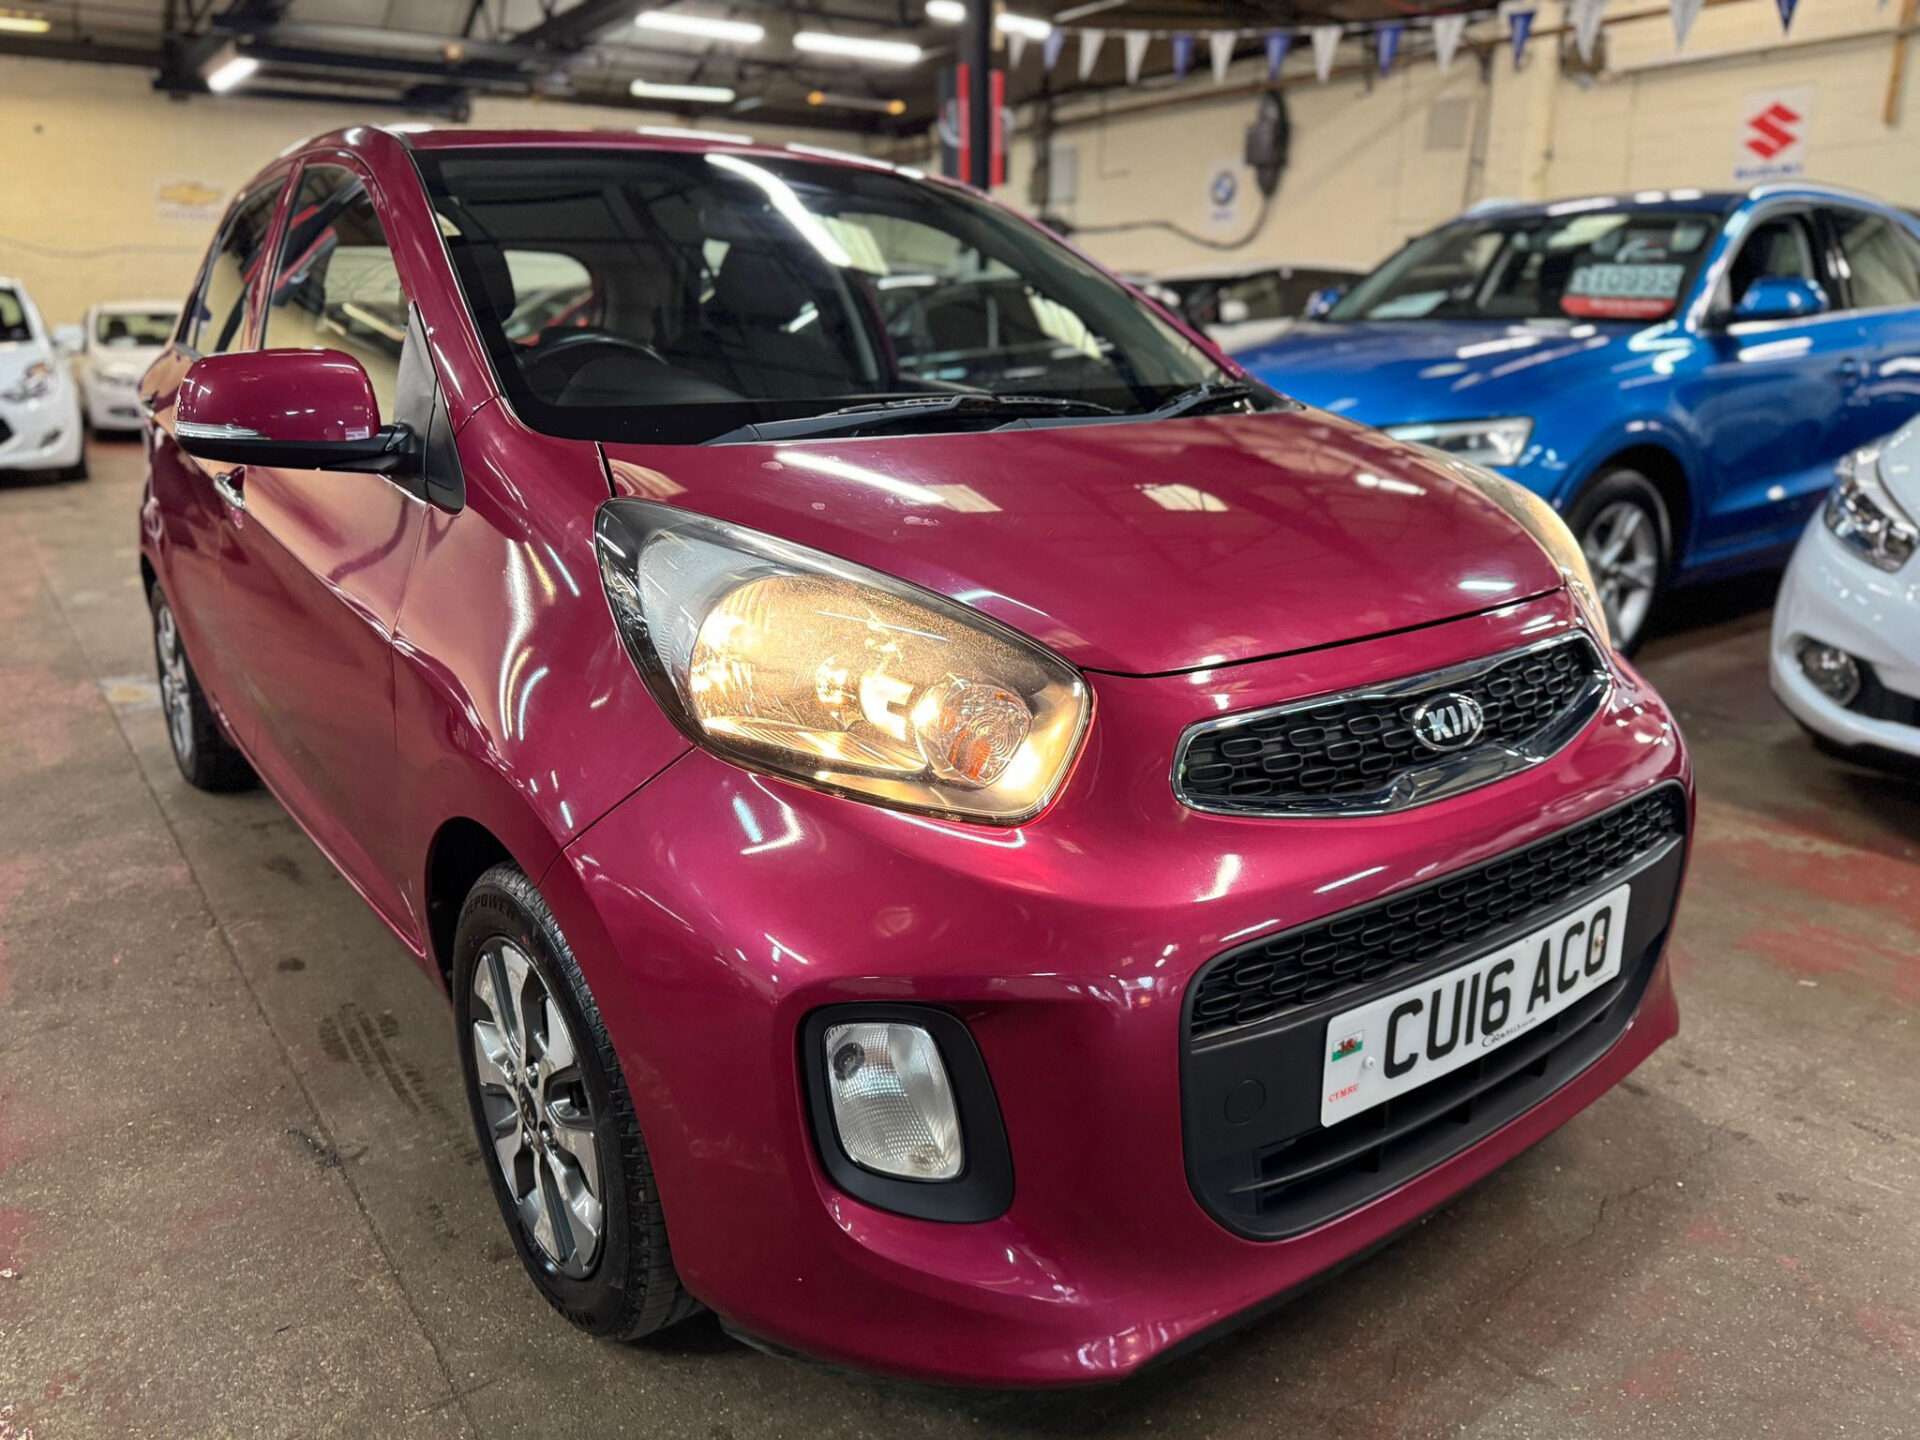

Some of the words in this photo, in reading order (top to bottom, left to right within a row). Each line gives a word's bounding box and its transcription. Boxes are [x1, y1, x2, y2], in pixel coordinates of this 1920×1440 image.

[1426, 702, 1477, 741] KIA
[1384, 957, 1515, 1079] CU16
[1526, 906, 1612, 1014] ACO
